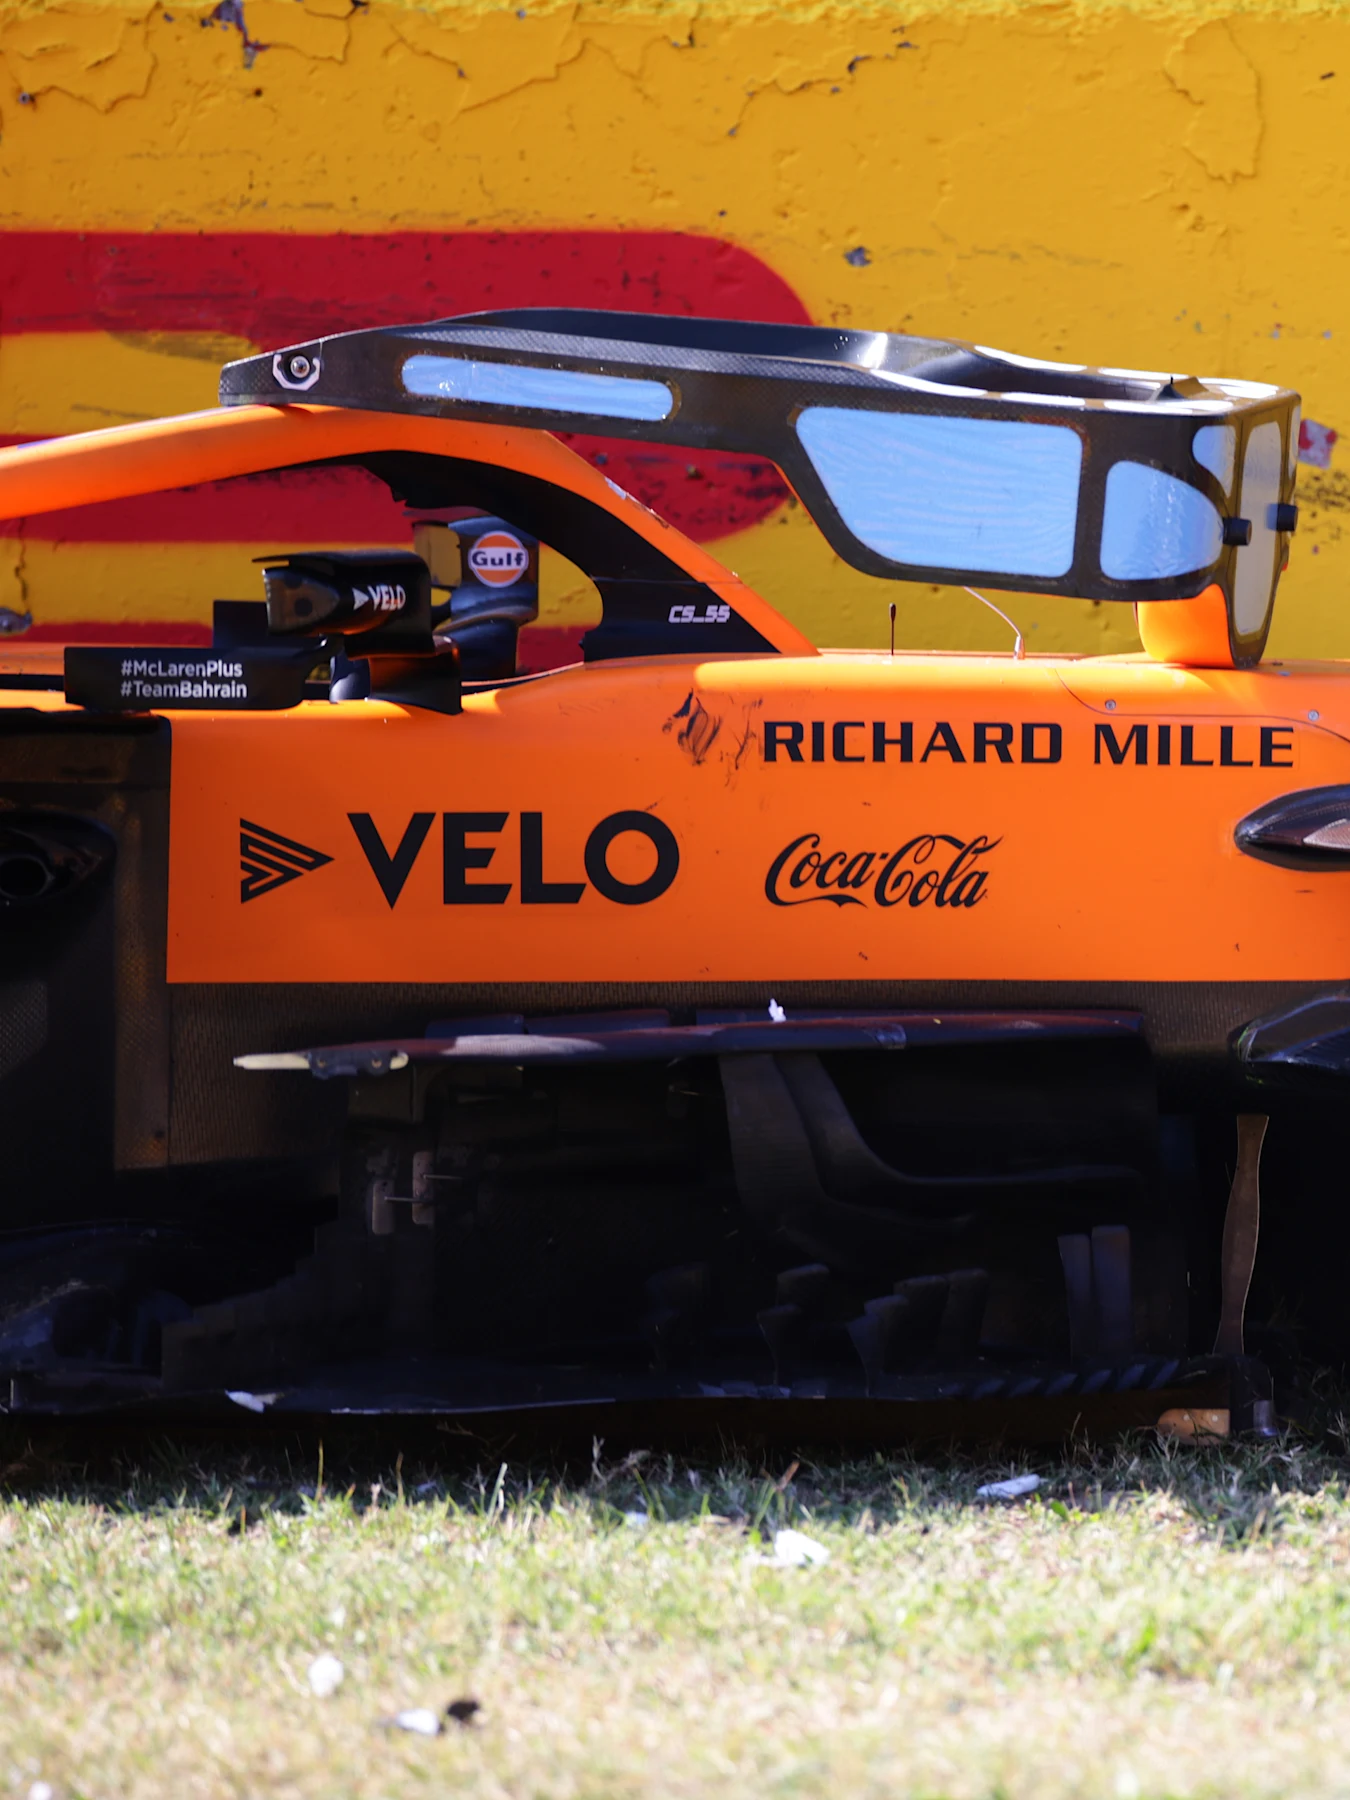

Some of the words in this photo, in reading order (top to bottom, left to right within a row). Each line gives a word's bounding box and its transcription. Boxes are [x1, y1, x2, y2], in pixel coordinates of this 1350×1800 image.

[471, 550, 524, 567] Gulf
[367, 584, 406, 611] VELO
[668, 604, 731, 624] CS_55
[121, 660, 243, 677] #McLarenPlus
[120, 680, 247, 698] #TeamBahrain
[763, 721, 1063, 763] RICHARD
[1093, 724, 1294, 768] MILLE
[346, 809, 680, 911] VELO
[764, 833, 1004, 908] Coca-Cola
